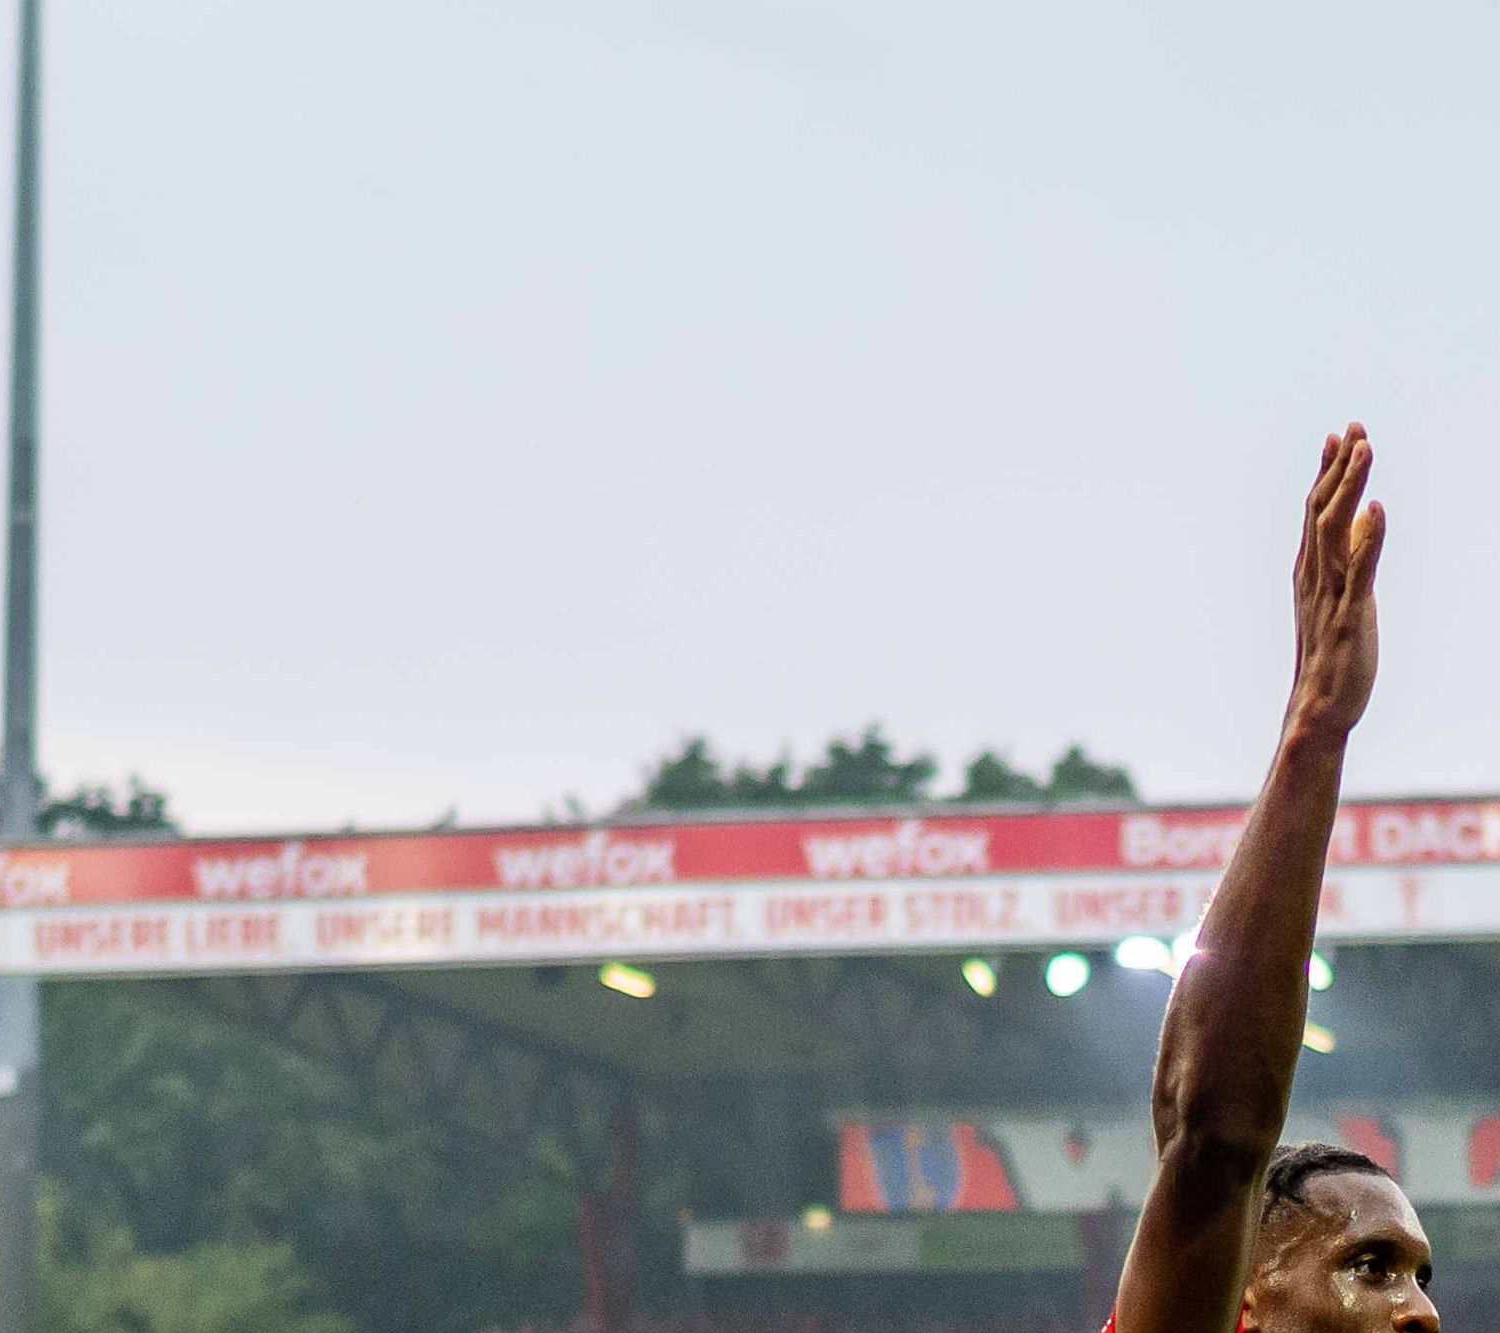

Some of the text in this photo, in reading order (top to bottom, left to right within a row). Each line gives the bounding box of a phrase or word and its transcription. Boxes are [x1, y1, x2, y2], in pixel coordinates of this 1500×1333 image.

[194, 842, 367, 899] wefox
[495, 831, 675, 888] wefox
[802, 820, 992, 880] wefox
